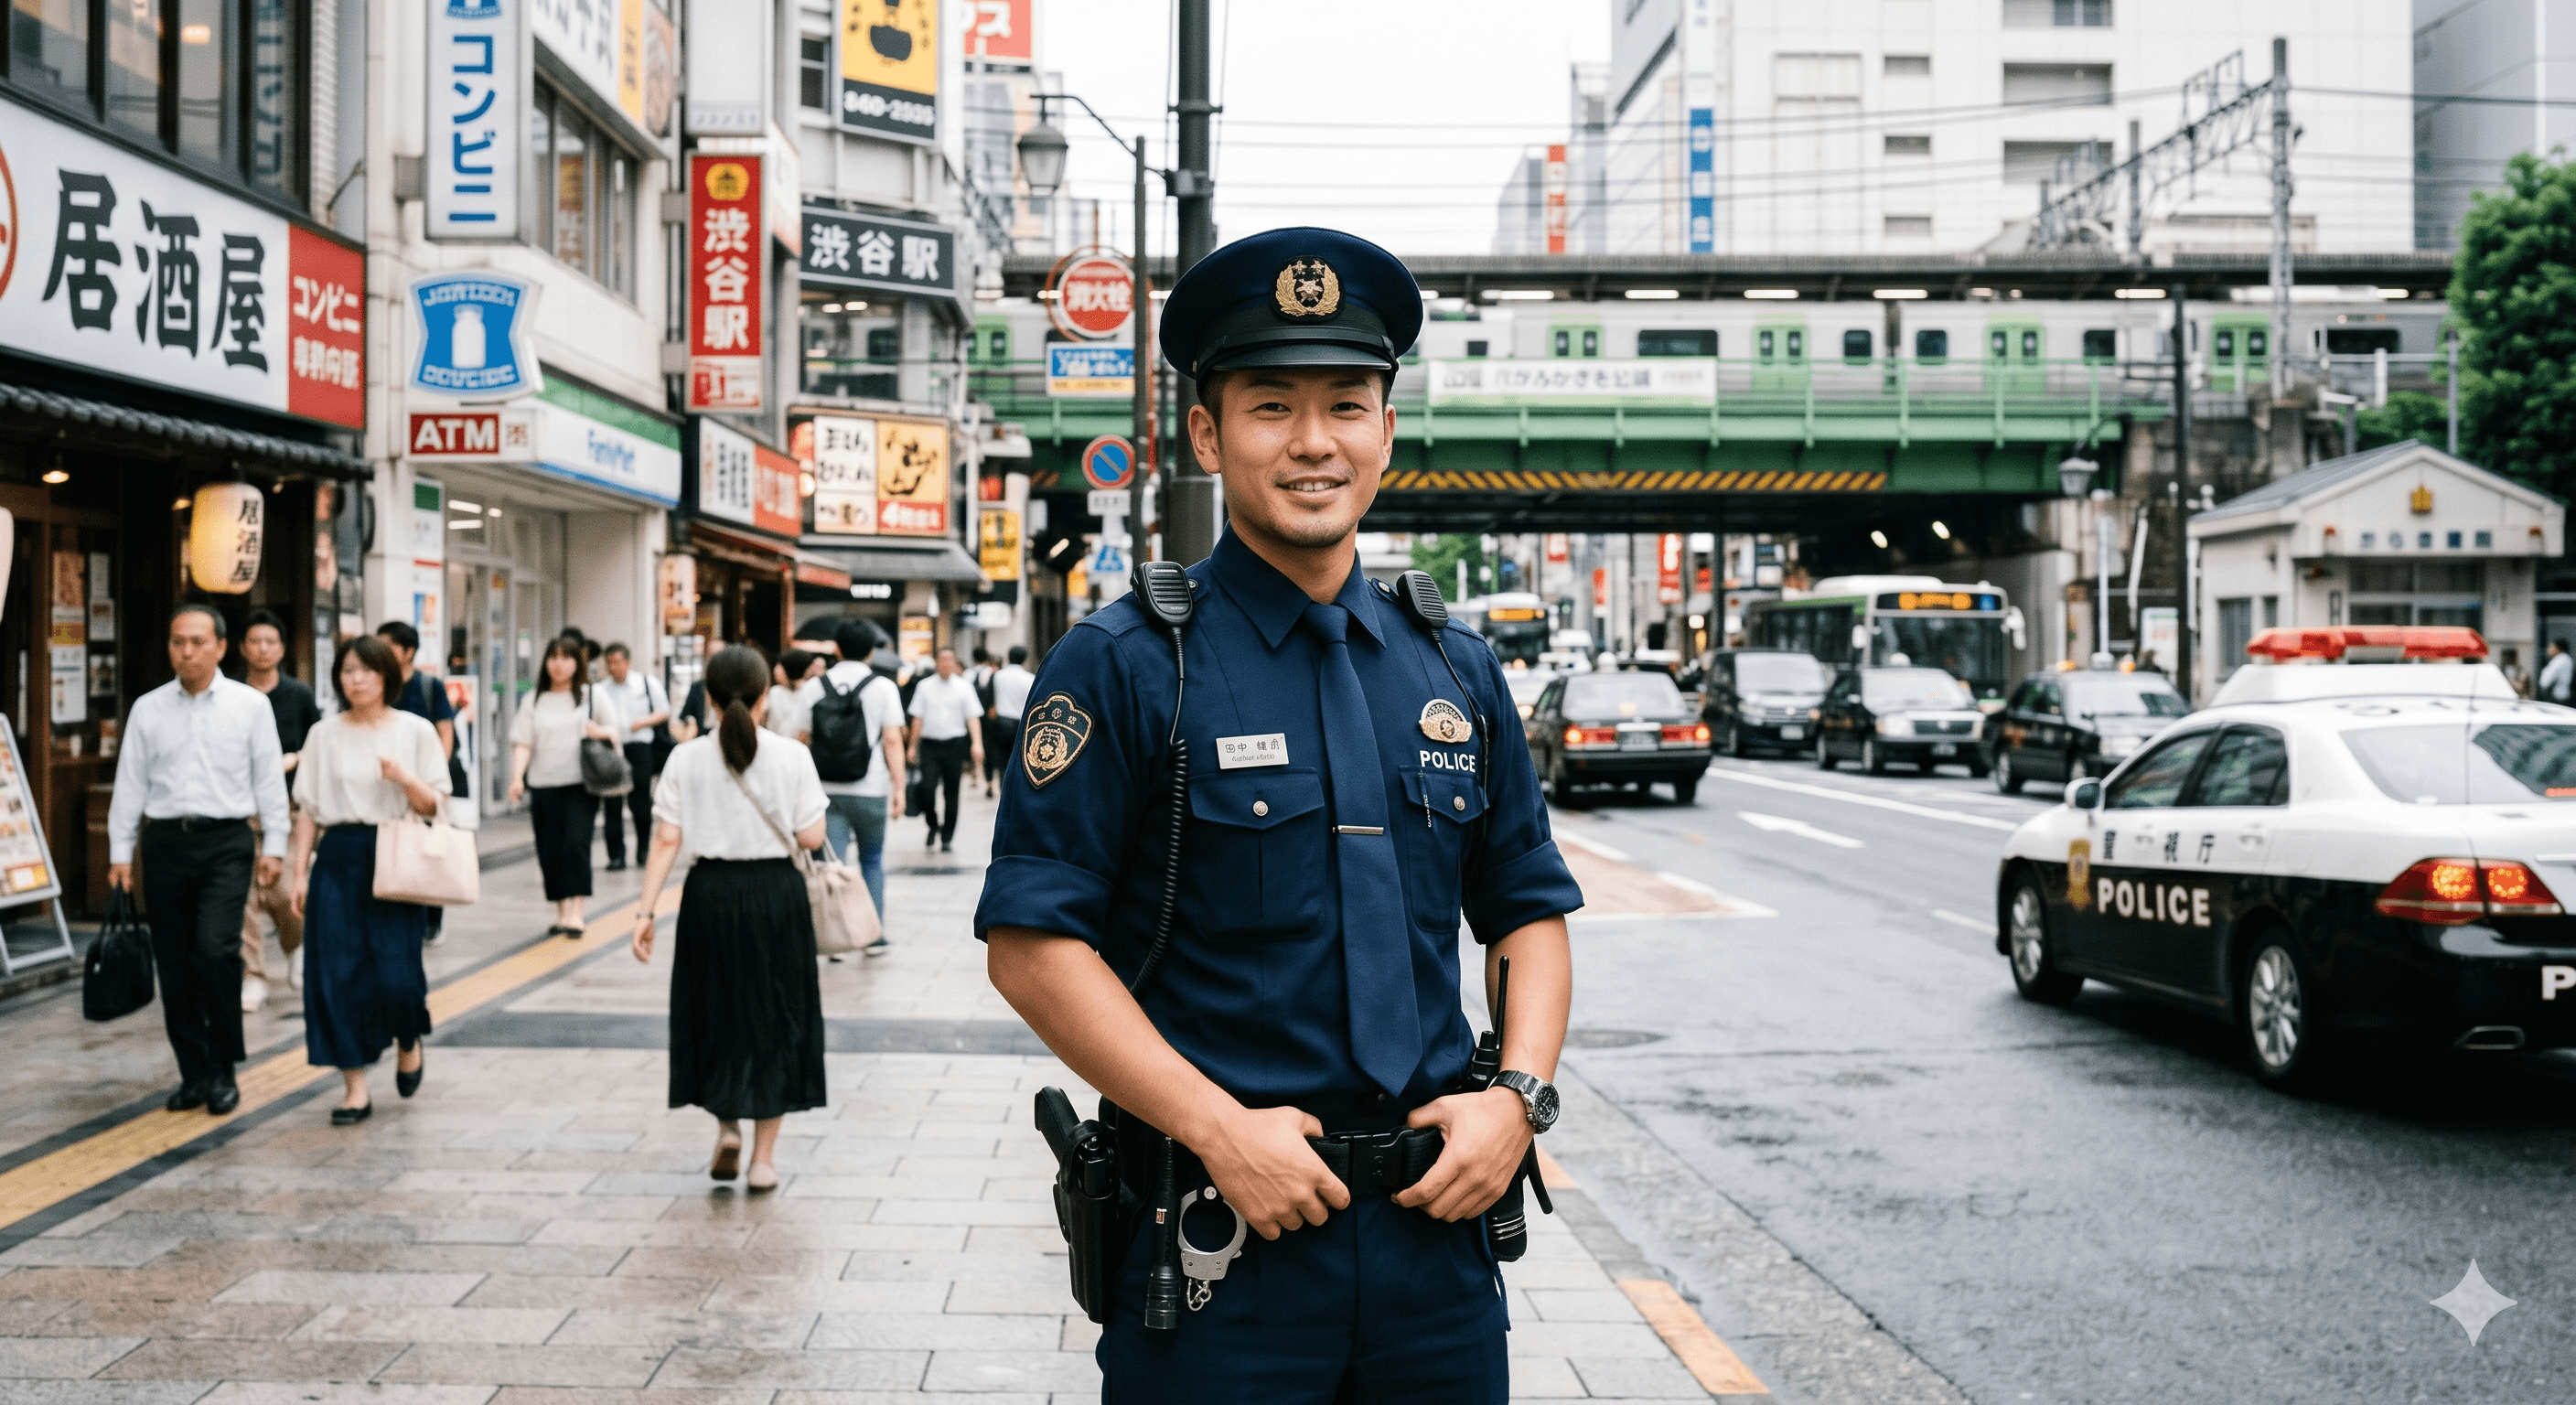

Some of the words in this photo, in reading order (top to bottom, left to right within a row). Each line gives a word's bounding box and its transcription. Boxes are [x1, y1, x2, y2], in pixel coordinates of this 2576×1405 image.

[449, 35, 498, 222] コンビニ
[42, 167, 269, 374] 居酒屋
[703, 208, 751, 349] 渋谷駅
[810, 222, 940, 282] 渋谷駅
[293, 274, 360, 335] コンビニ
[414, 418, 497, 451] ATM
[1419, 750, 1476, 773] POLICE
[2098, 877, 2212, 928] POLICE
[2542, 965, 2576, 1001] P
